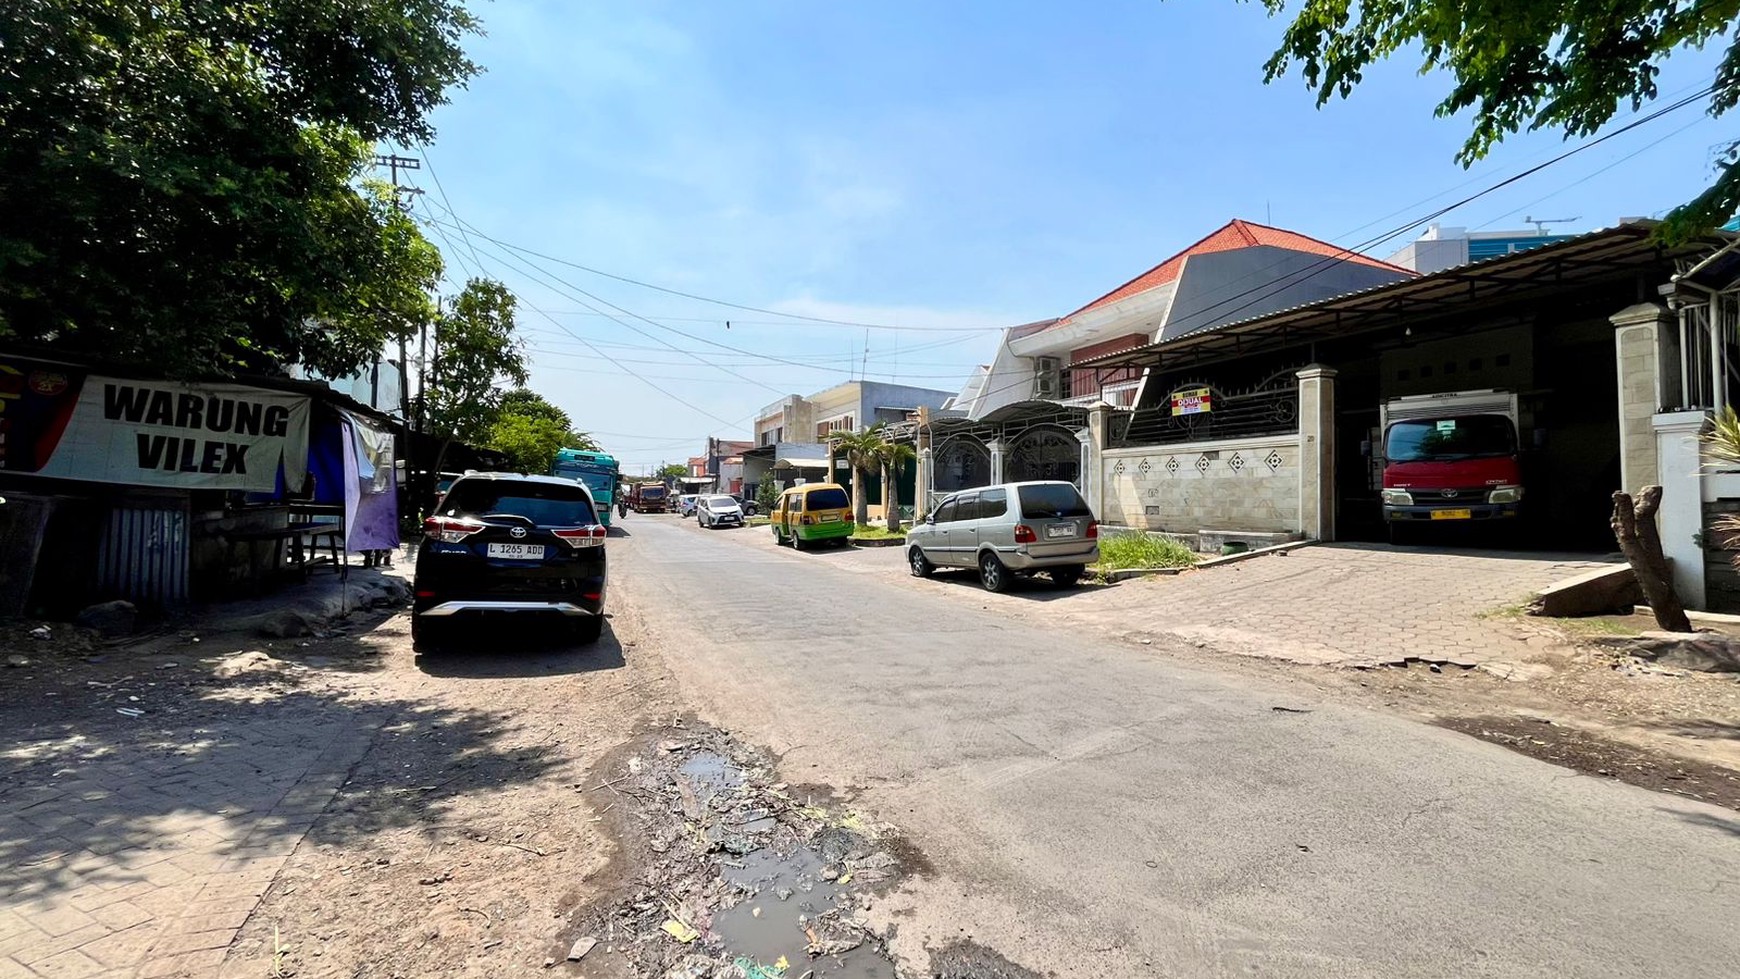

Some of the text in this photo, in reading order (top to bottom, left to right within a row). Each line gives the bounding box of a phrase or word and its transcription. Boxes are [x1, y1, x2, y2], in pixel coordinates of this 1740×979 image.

[104, 383, 289, 437] WARUNG
[1177, 396, 1203, 406] DIJUAL
[136, 433, 250, 475] VILEX
[489, 544, 544, 555] L 1265 ADD
